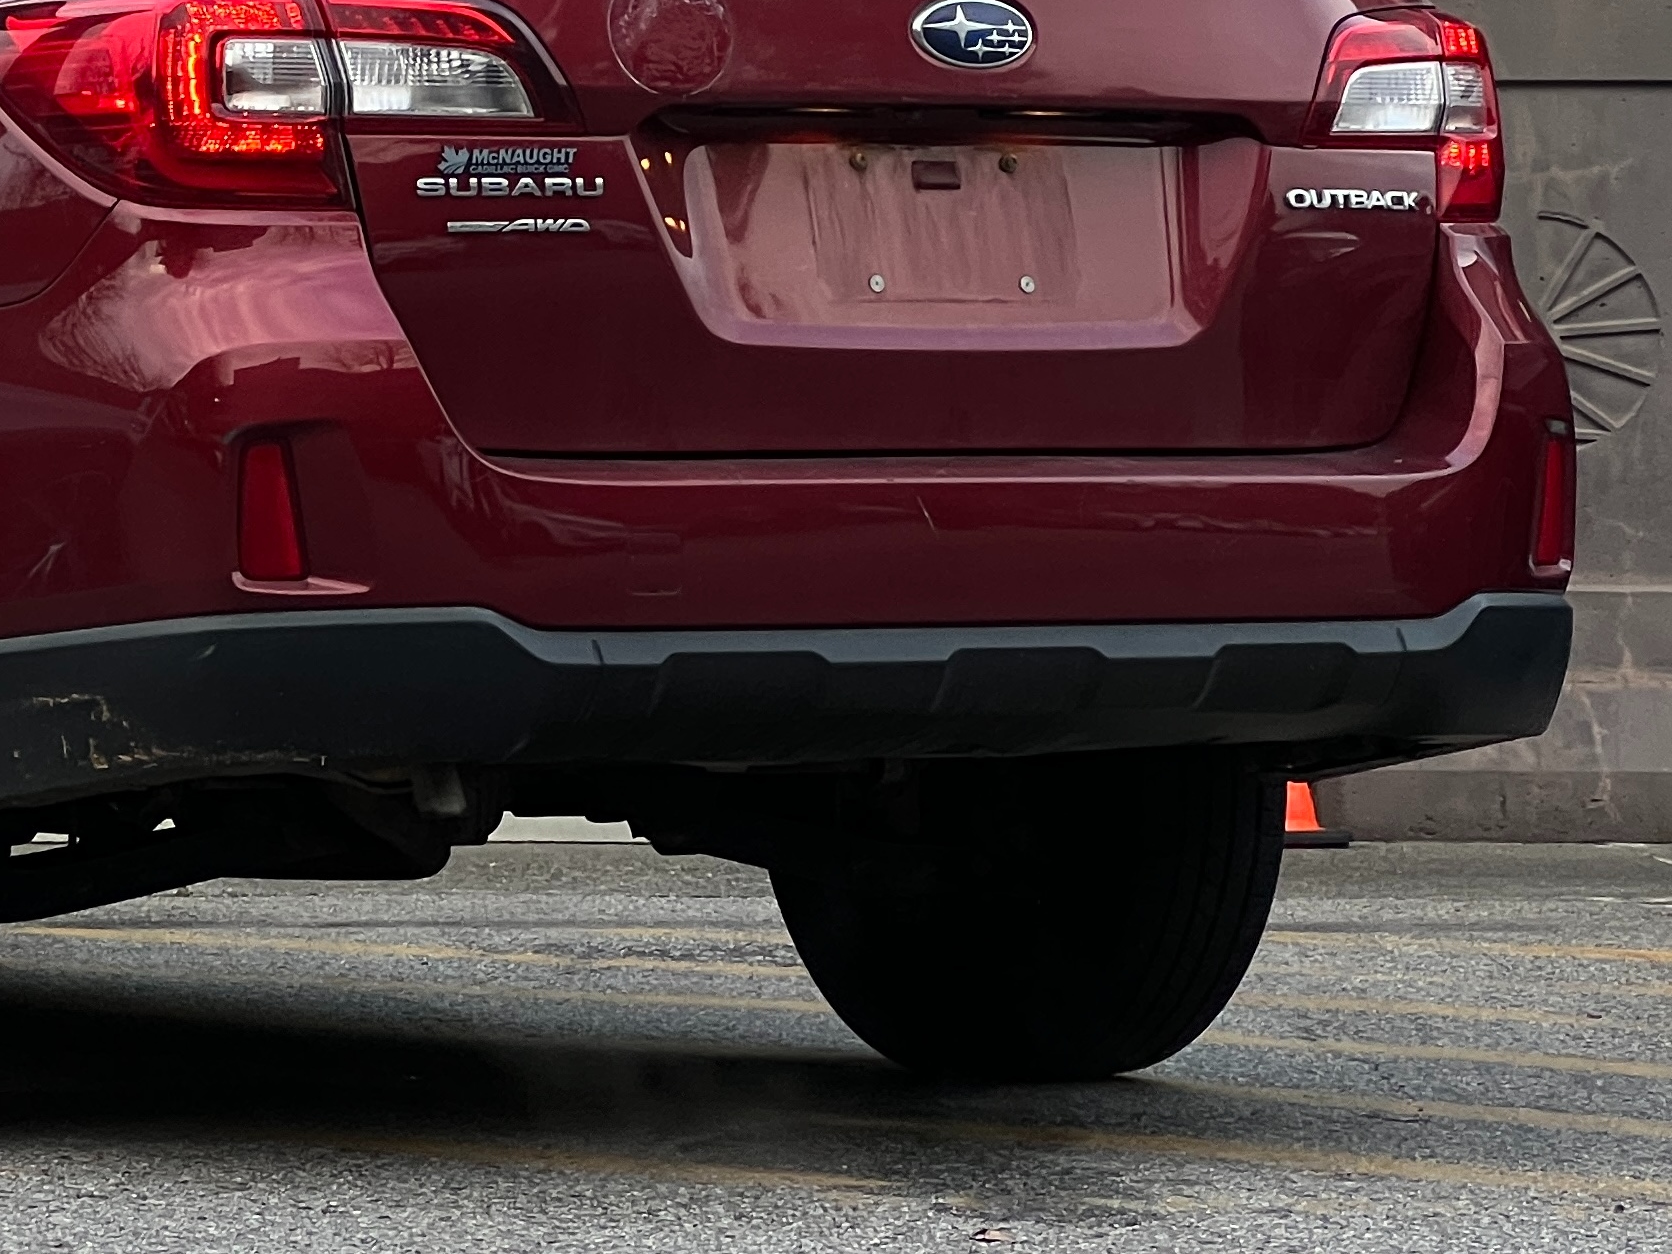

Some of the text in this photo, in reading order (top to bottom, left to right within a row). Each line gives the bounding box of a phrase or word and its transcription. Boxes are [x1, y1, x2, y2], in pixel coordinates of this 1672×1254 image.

[471, 147, 578, 164] McNAUGHT
[416, 177, 604, 197] SUBARU
[1286, 188, 1419, 210] OUTBACK
[501, 218, 591, 233] AWD
